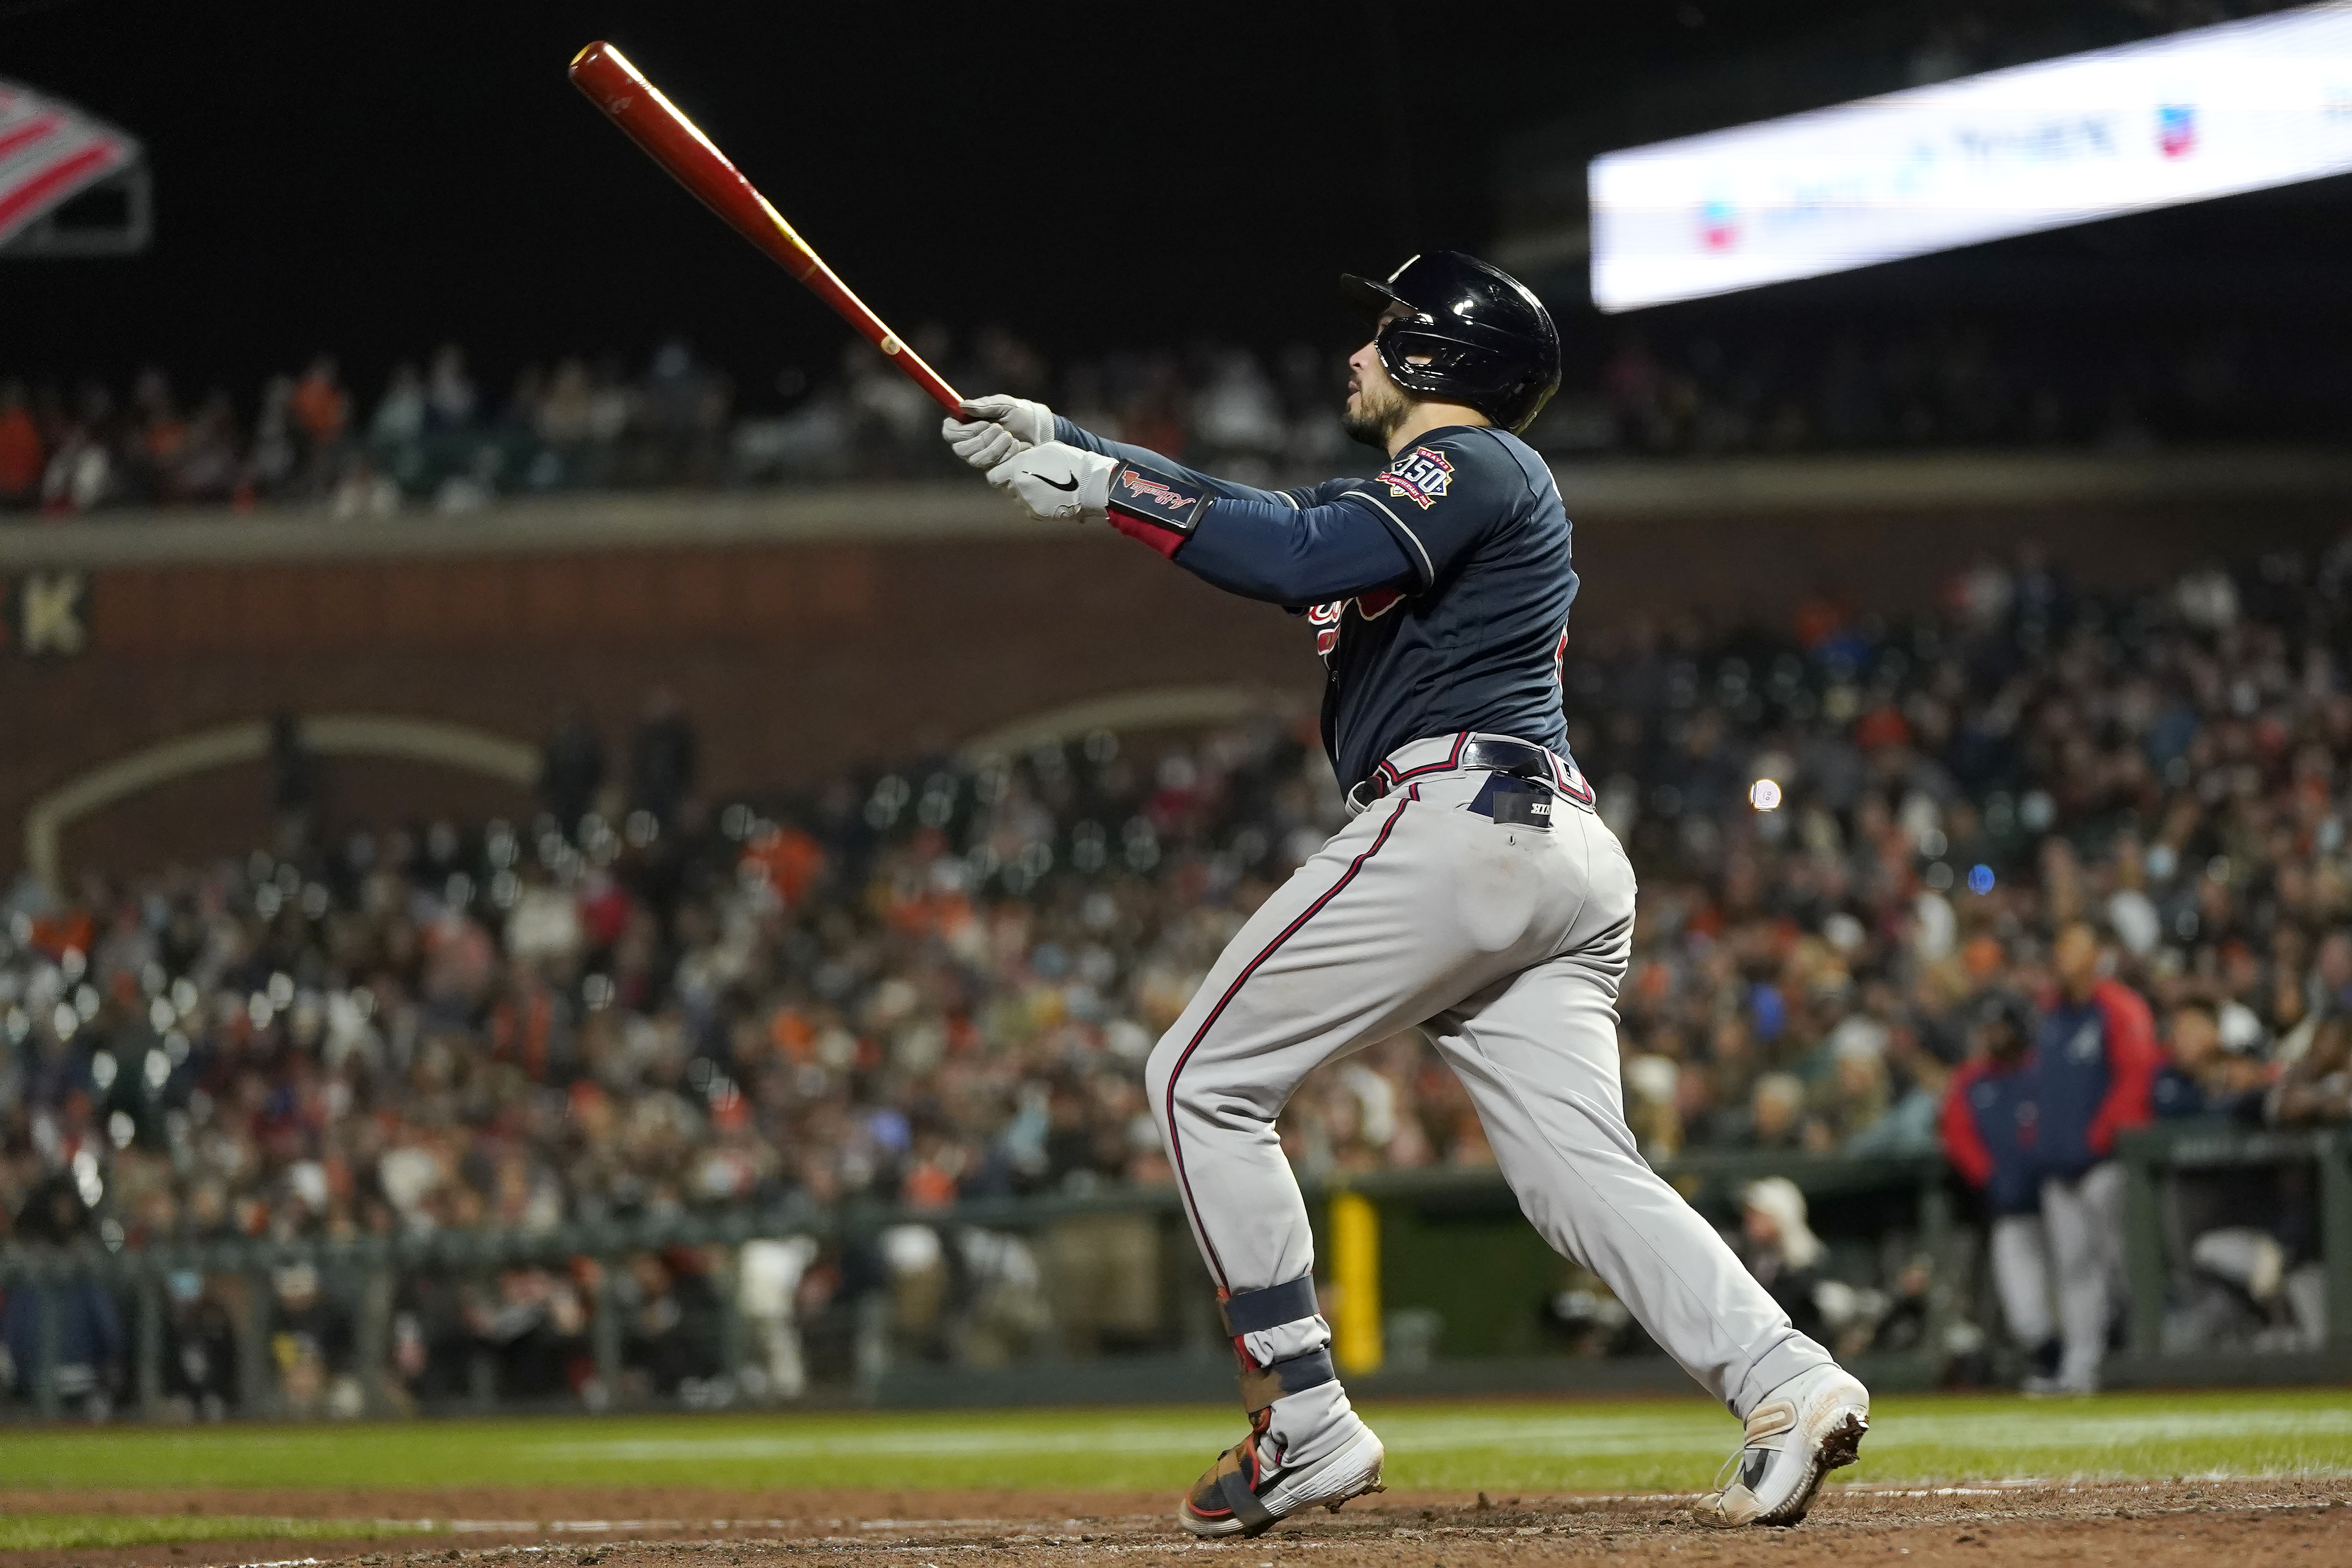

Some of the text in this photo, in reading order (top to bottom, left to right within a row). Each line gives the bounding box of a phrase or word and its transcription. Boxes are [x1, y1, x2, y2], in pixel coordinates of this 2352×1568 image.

[1421, 450, 1448, 470] BRAVES
[1389, 477, 1419, 496] ANNIVERSARY
[1392, 455, 1446, 493] 150
[1130, 483, 1196, 510] Atlanta
[24, 575, 82, 652] K
